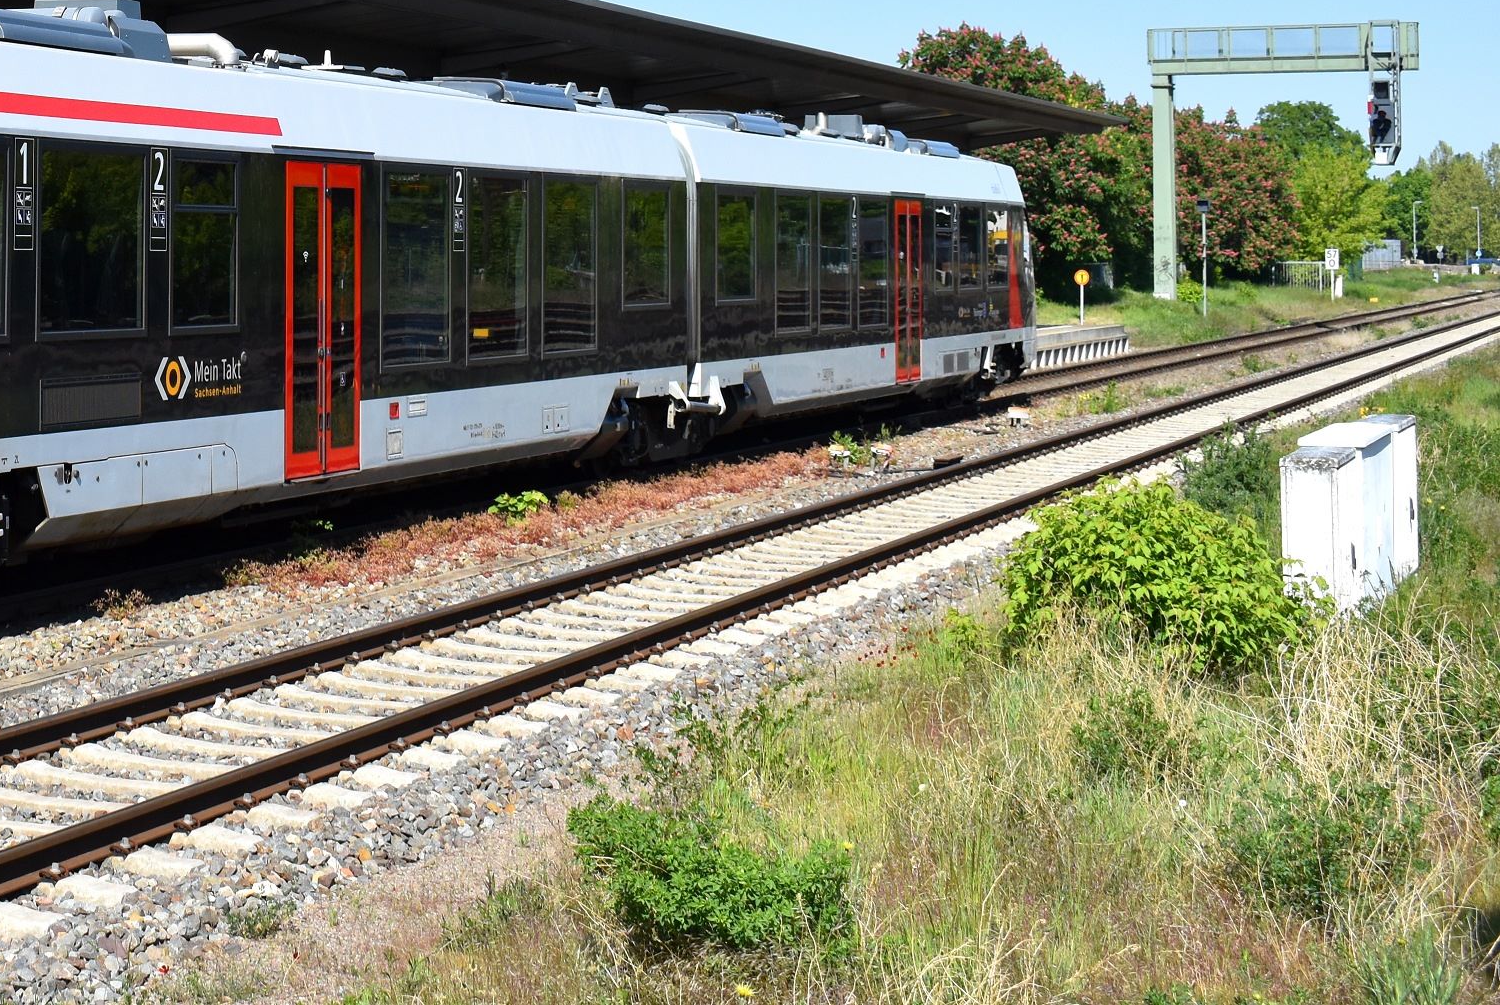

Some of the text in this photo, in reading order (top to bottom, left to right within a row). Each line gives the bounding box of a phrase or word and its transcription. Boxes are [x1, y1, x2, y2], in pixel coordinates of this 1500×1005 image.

[19, 142, 28, 185] 1
[154, 151, 164, 191] 2
[455, 170, 463, 203] 2
[1326, 249, 1338, 259] 57
[194, 357, 242, 383] Mein Takt
[194, 385, 242, 399] Sachsen-Anhalt
